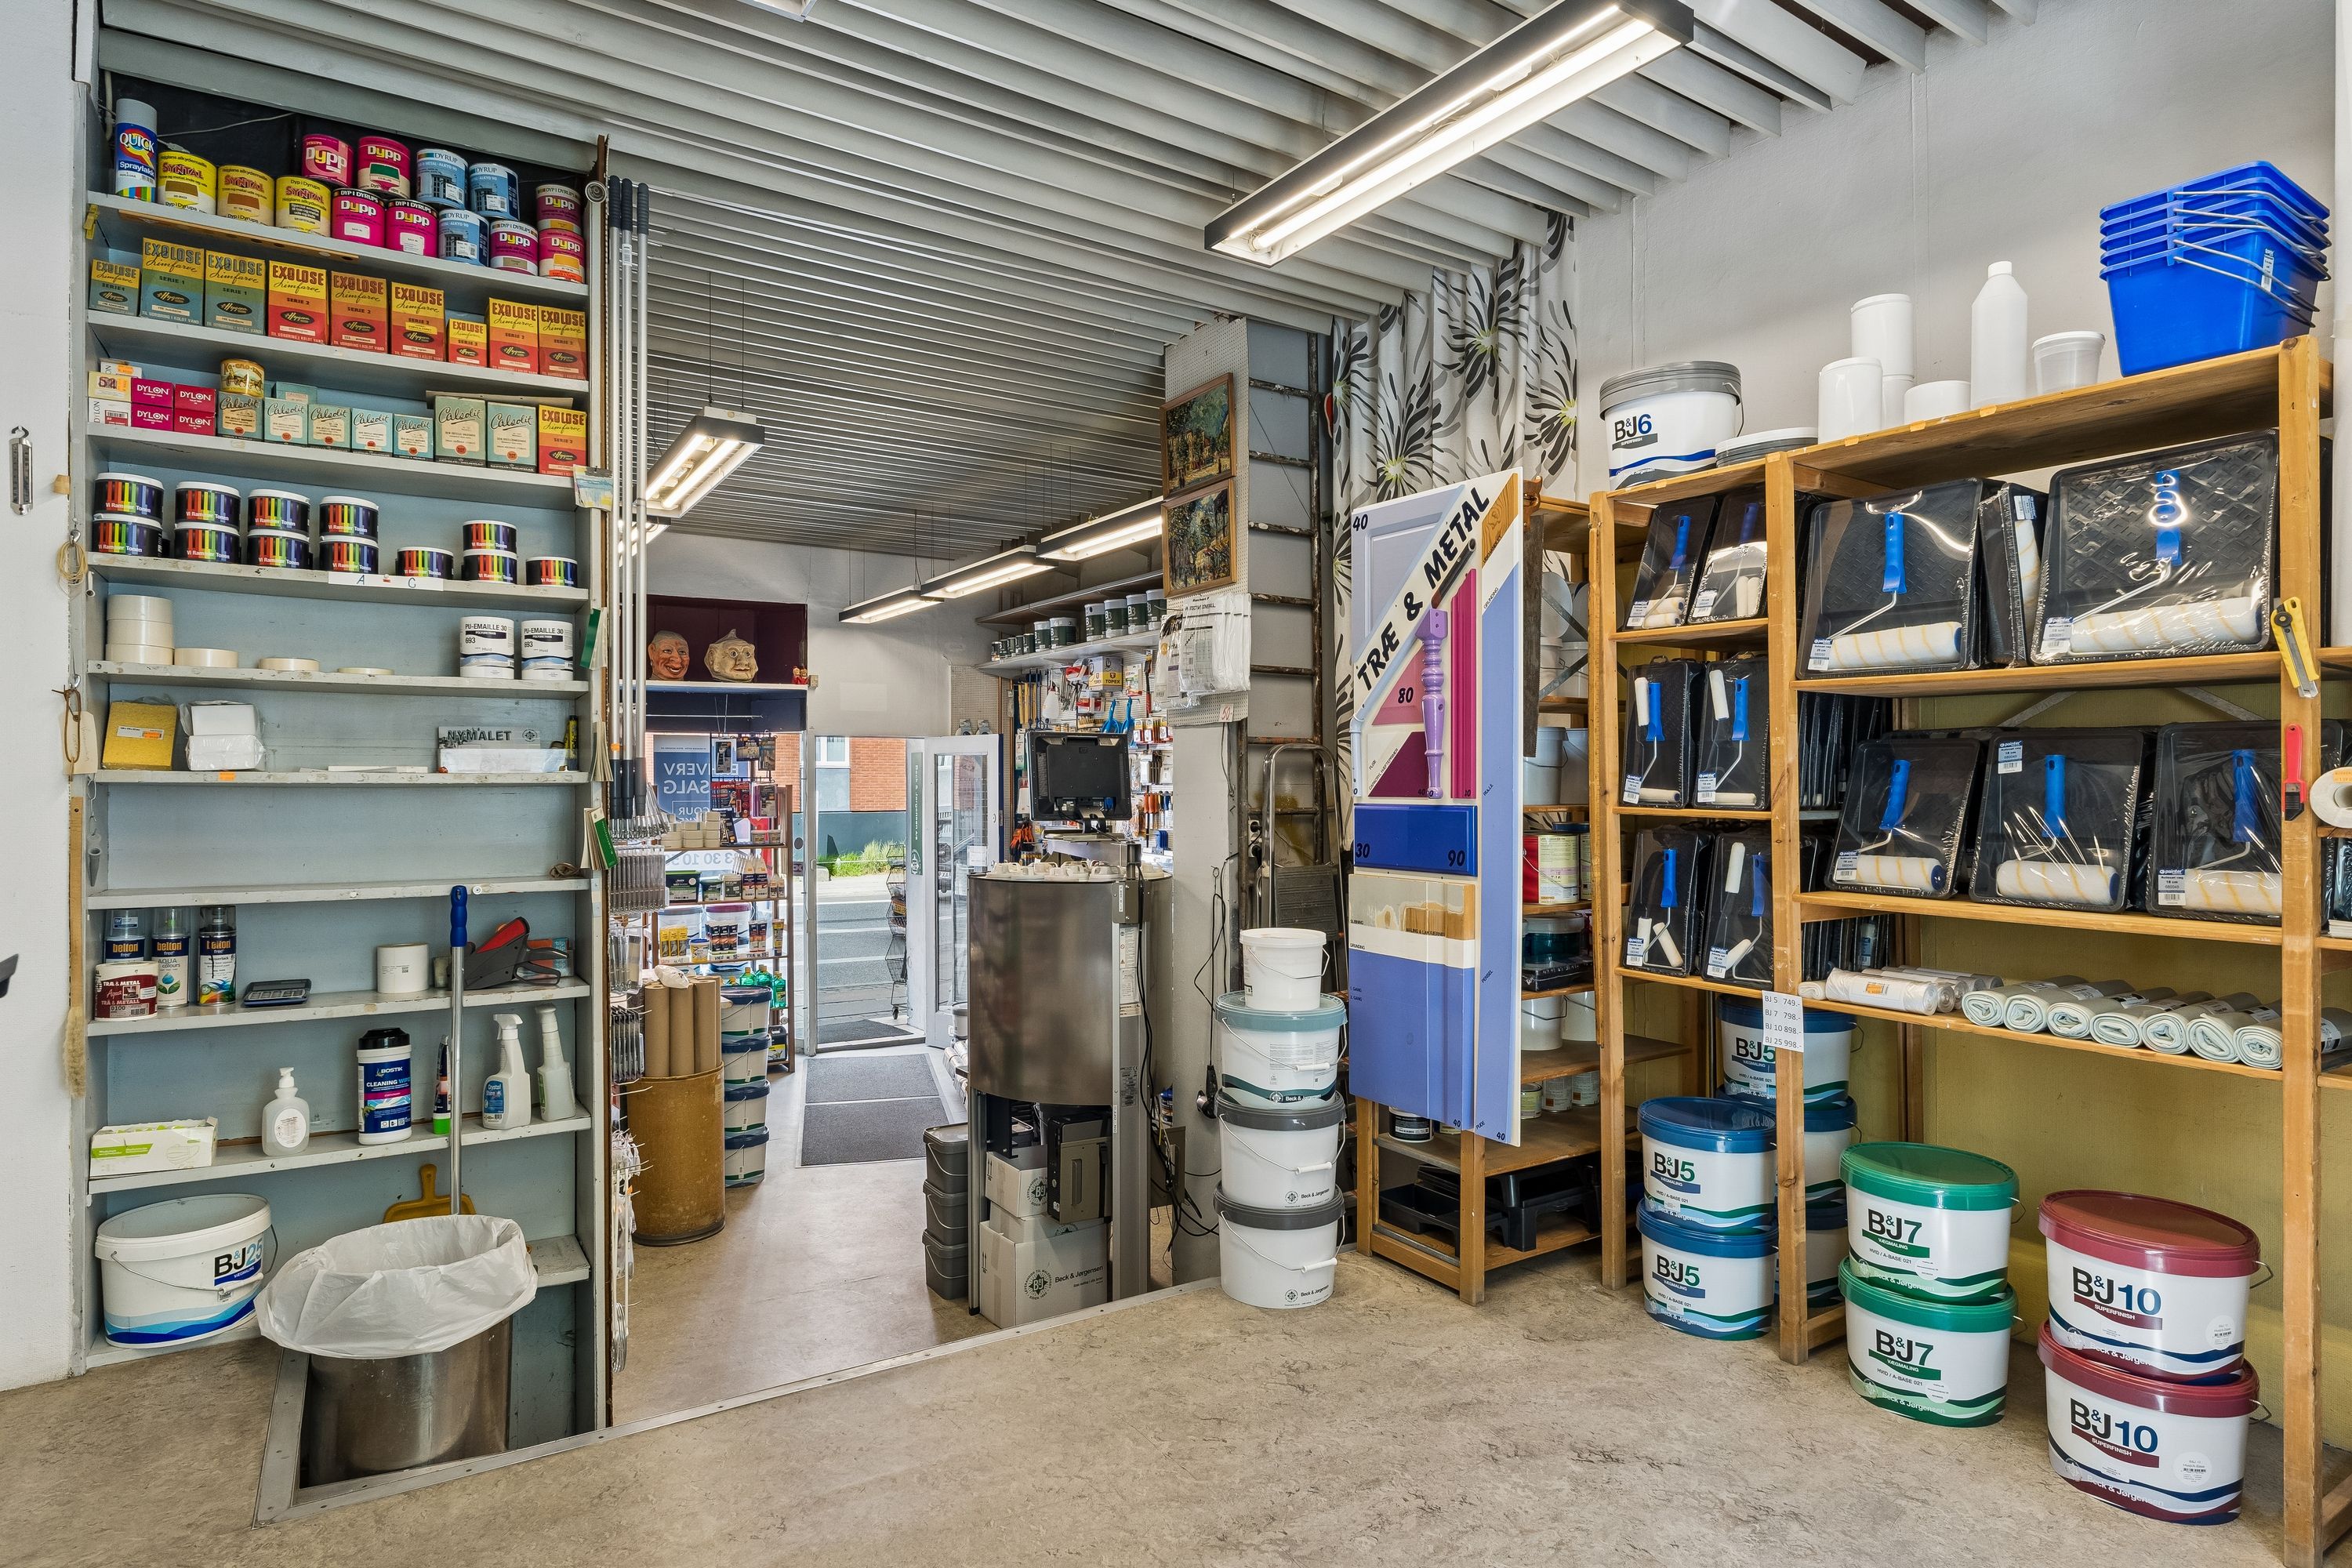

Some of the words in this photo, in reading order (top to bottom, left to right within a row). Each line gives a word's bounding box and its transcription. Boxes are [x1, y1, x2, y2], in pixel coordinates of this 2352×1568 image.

[119, 132, 154, 153] QUICK
[306, 147, 347, 169] Dypp
[367, 145, 401, 162] Dypp
[434, 152, 458, 163] DYRUP
[162, 162, 204, 180] SYNTAL
[224, 174, 264, 193] SYNTAL
[285, 186, 325, 204] SYNTAL
[340, 200, 376, 216] Dypp
[545, 196, 575, 210] Dypp
[395, 210, 430, 227] Dypp
[499, 233, 531, 247] Dypp
[551, 238, 581, 252] Dypp
[136, 384, 169, 395] DYLON
[180, 390, 212, 401] DYLON
[136, 410, 169, 421] DYLON
[267, 401, 305, 417] Calsolit
[310, 407, 348, 421] Calsolit
[438, 406, 482, 424] Calsolit
[490, 412, 533, 430] Calsolit
[136, 505, 151, 514] Tonen
[1352, 514, 1368, 532] 40
[356, 575, 365, 586] A
[408, 577, 416, 589] C
[1357, 621, 1400, 691] TRÆ
[1403, 591, 1424, 622] &
[1423, 486, 1490, 590] METAL
[1398, 687, 1414, 704] 80
[447, 729, 512, 742] NYMALET
[1356, 843, 1370, 858] 30
[1447, 850, 1465, 867] 90
[112, 943, 139, 953] belton
[157, 941, 182, 951] belton
[1481, 969, 1494, 984] PENSEL
[1783, 998, 1800, 1007] 749.-
[1784, 1011, 1801, 1021] 798.-
[1784, 1025, 1802, 1034] 898.-
[1784, 1040, 1802, 1049] 998.-
[1453, 1119, 1461, 1128] 40
[1475, 1120, 1486, 1130] PUDE
[1496, 1132, 1505, 1141] 40
[1654, 1151, 1696, 1182] B&J5
[1661, 1176, 1683, 1188] VÆGMALING
[1666, 1192, 1681, 1203] A-BASE
[1867, 1208, 1922, 1243] B&J7
[1878, 1237, 1908, 1251] VÆGMALING
[1868, 1247, 1880, 1256] HVID
[1882, 1251, 1902, 1262] A-BASE
[1054, 1274, 1069, 1283] Beck
[1076, 1265, 1103, 1278] Jørgensen
[1657, 1254, 1700, 1287] B&J5
[1033, 1277, 1044, 1291] B&J
[1663, 1279, 1687, 1292] VÆGMALING
[1874, 1270, 1889, 1283] Beck
[1896, 1278, 1935, 1293] Jørgensen
[2094, 1303, 2136, 1320] SUPERFINISH
[1876, 1329, 1934, 1367] B&J7
[2089, 1340, 2110, 1356] Beck
[2111, 1348, 2118, 1357] &
[2119, 1351, 2168, 1370] Jørgensen
[1887, 1359, 1919, 1373] VÆGMALING
[1877, 1367, 1889, 1377] HVID
[1892, 1372, 1913, 1383] A-BASE
[1882, 1391, 1899, 1403] Beck
[1906, 1399, 1945, 1414] Jørgensen
[2091, 1437, 2132, 1457] SUPERFINISH
[2087, 1475, 2107, 1490] Beck
[2108, 1483, 2115, 1492] &
[2116, 1486, 2164, 1508] Jørgensen
